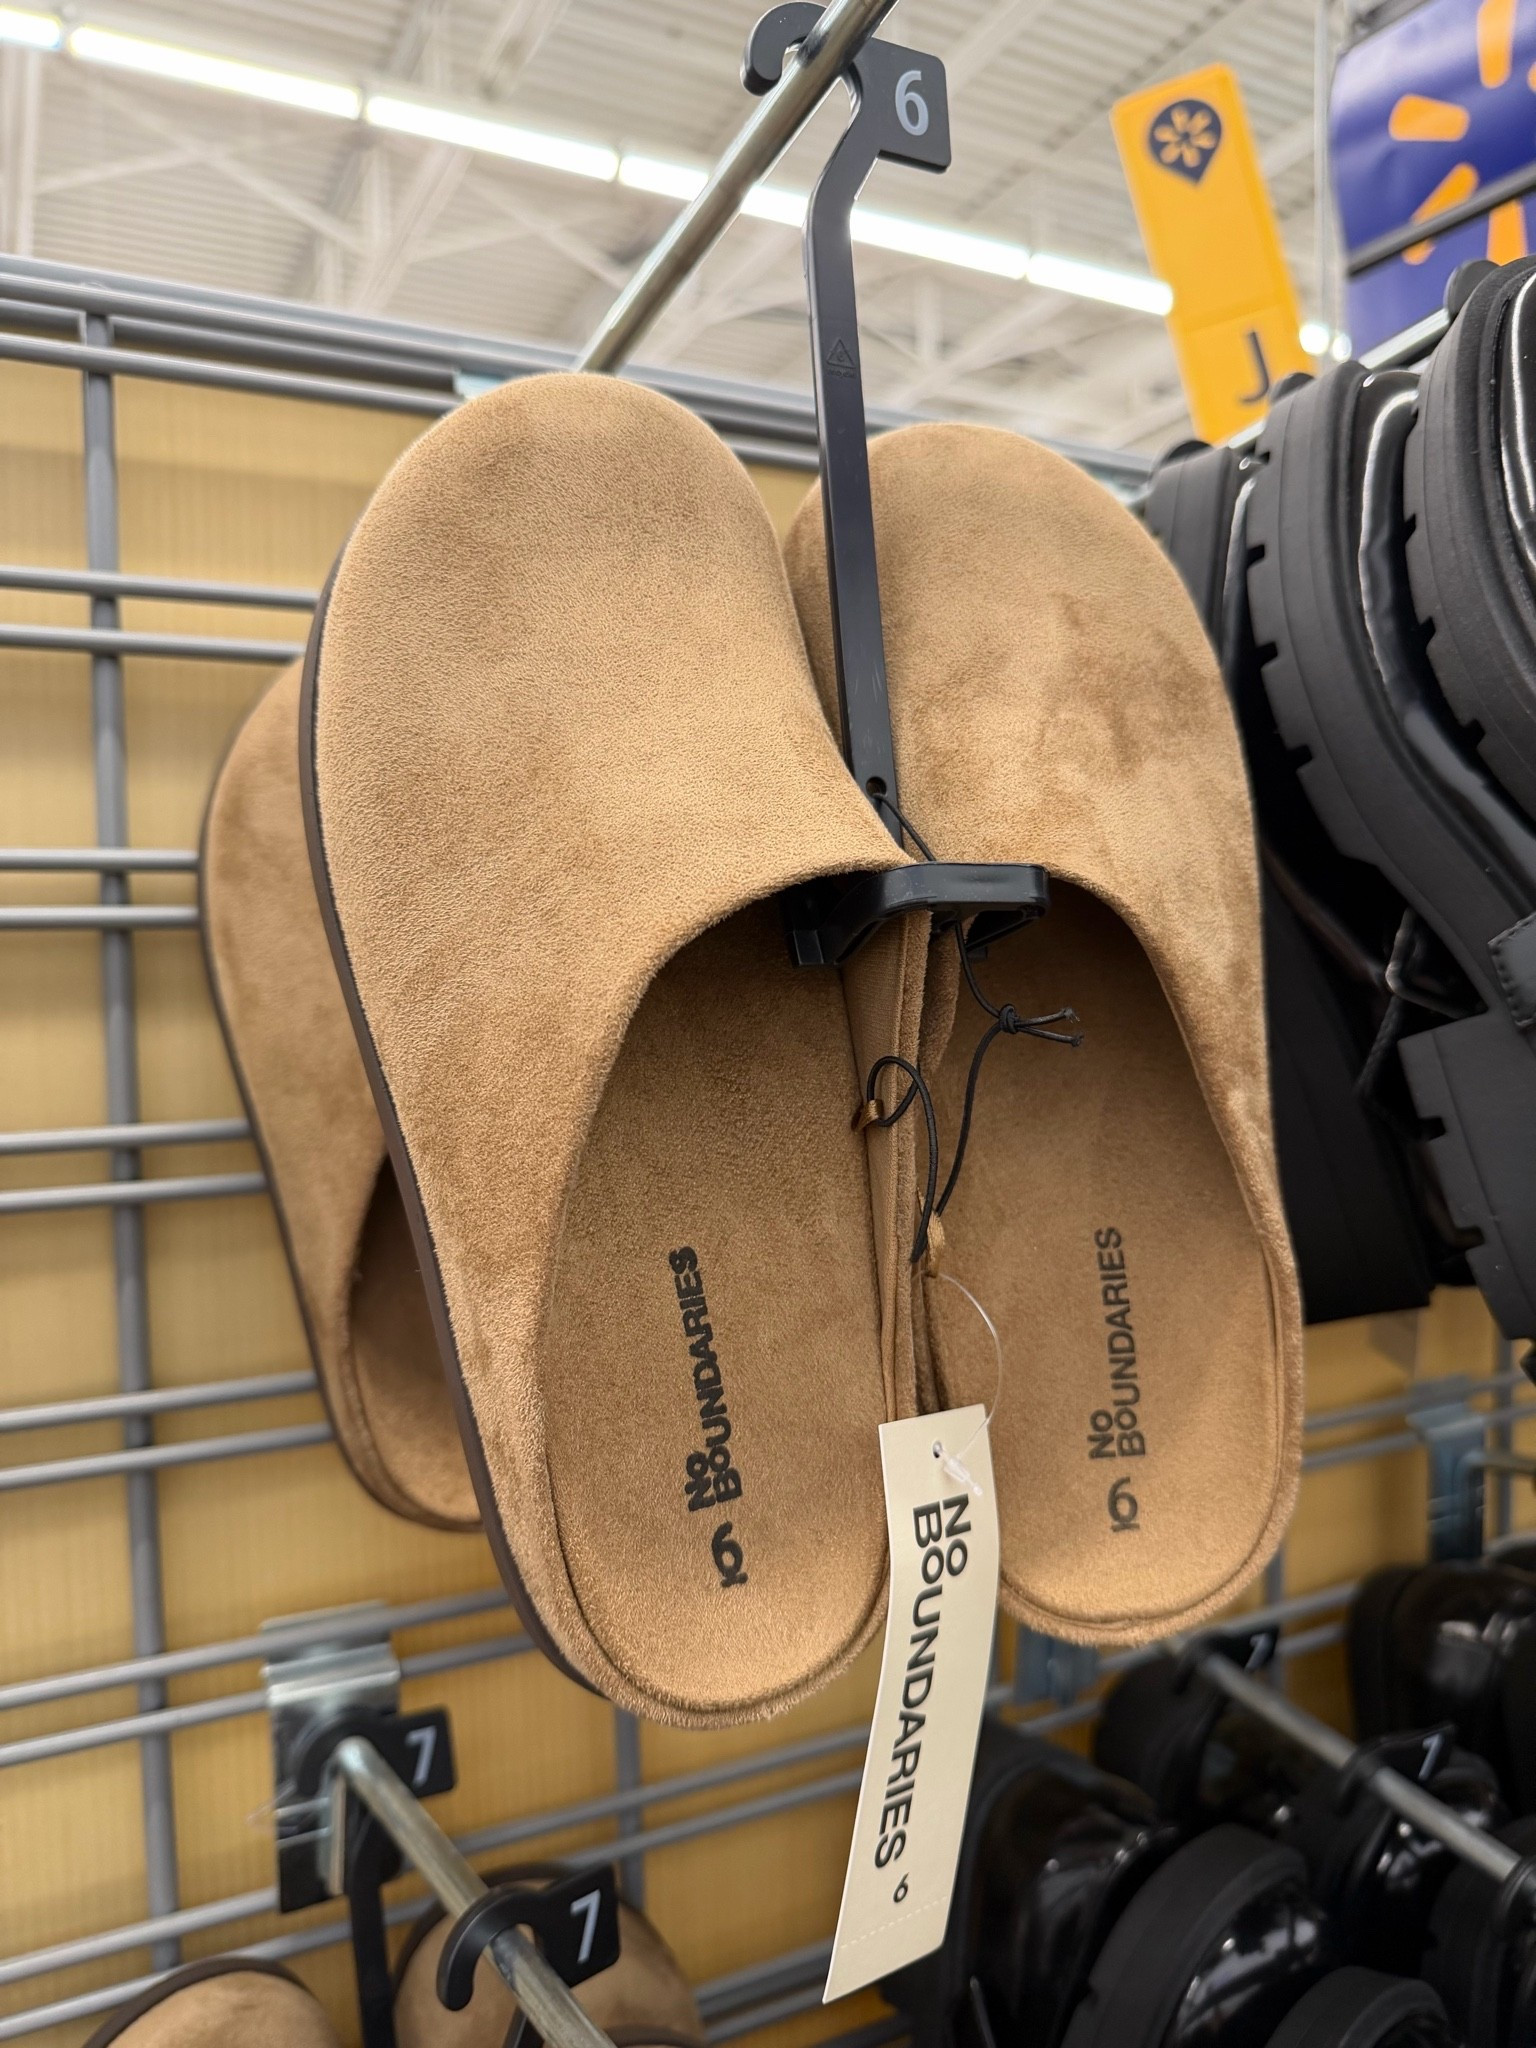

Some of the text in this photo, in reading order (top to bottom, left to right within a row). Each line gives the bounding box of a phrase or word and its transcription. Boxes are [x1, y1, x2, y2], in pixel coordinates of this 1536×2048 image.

[895, 69, 929, 136] 6
[1239, 331, 1269, 404] J
[669, 1246, 742, 1503] BOUNDARIES
[1095, 1226, 1146, 1457] BOUNDARIES
[1088, 1410, 1116, 1459] NO
[685, 1450, 716, 1512] NO
[1108, 1477, 1139, 1531] 6
[711, 1521, 748, 1588] 6
[942, 1494, 972, 1577] NO
[874, 1502, 945, 1869] BOUNDARIES
[405, 1726, 436, 1785] 7
[892, 1873, 909, 1904] 6
[570, 1889, 602, 1963] 7
